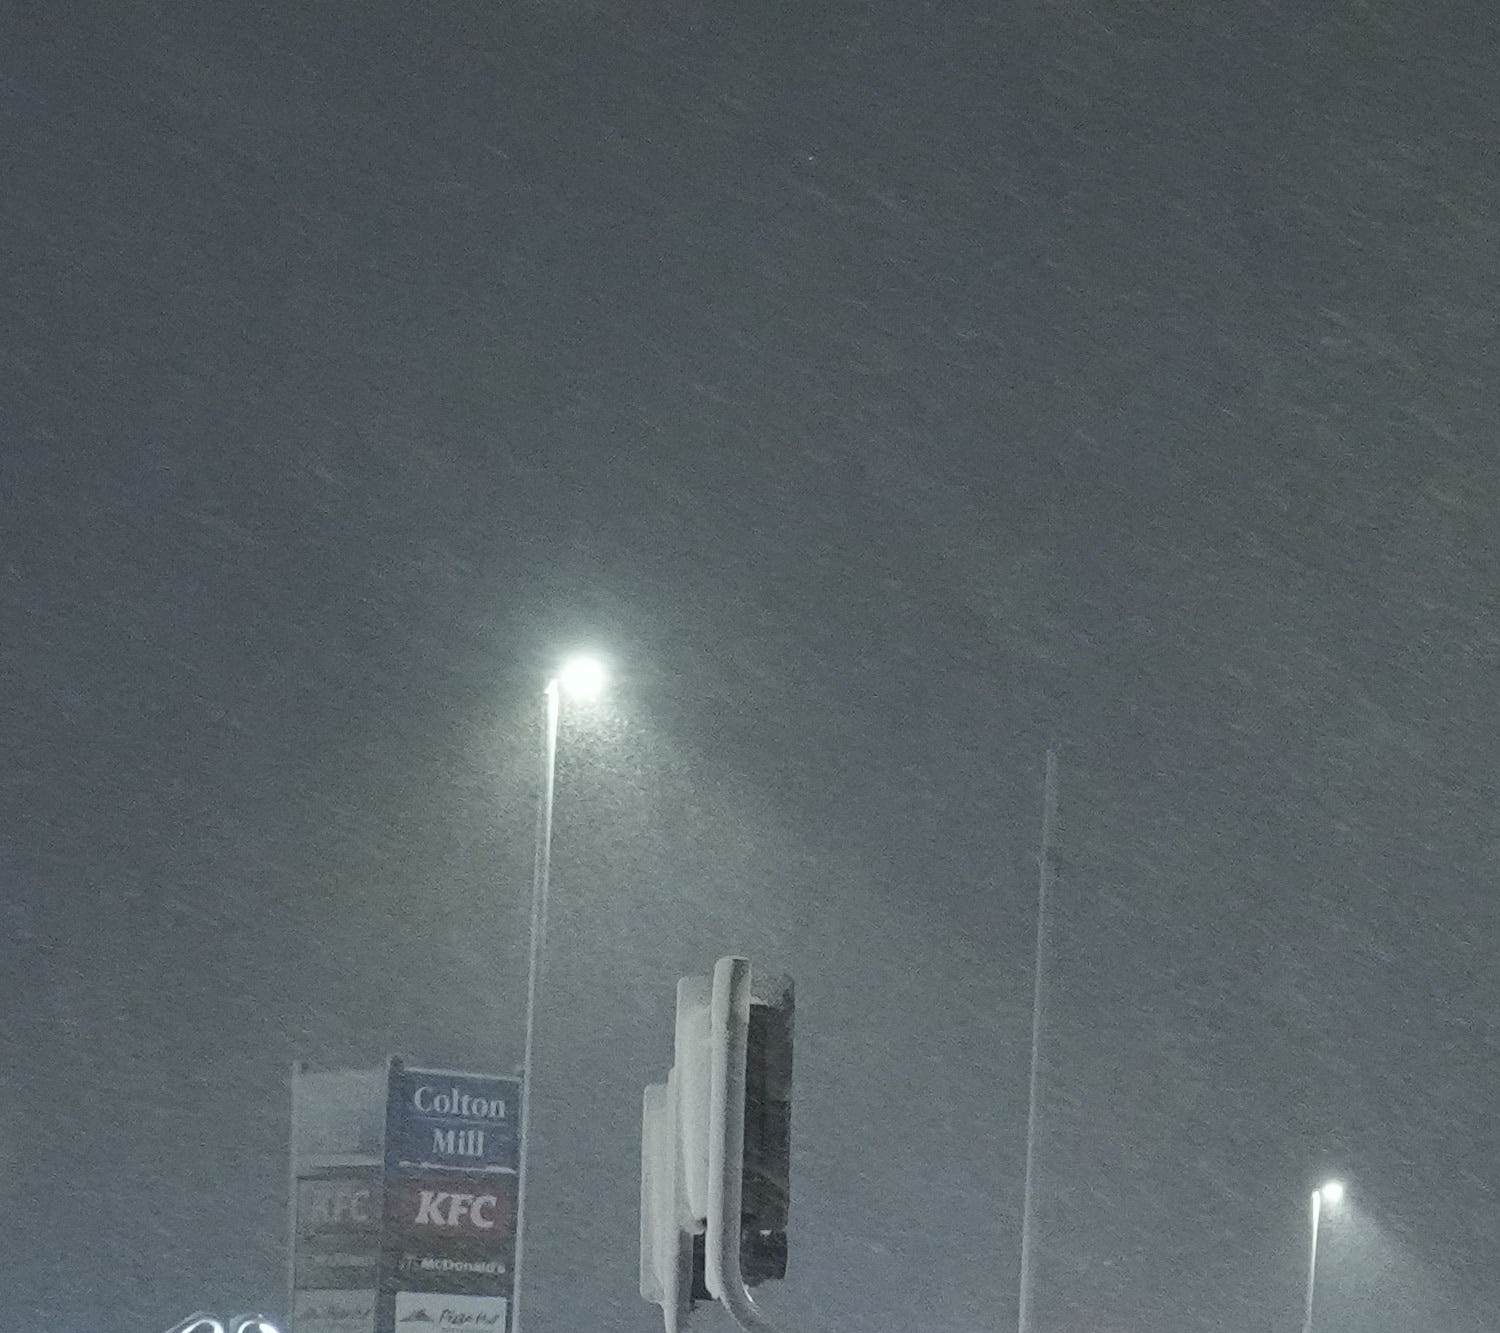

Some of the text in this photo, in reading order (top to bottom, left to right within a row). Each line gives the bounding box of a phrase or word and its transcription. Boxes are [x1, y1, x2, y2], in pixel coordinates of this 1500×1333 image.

[413, 1085, 506, 1119] Colton
[431, 1127, 485, 1158] Mill
[413, 1189, 499, 1229] KFC
